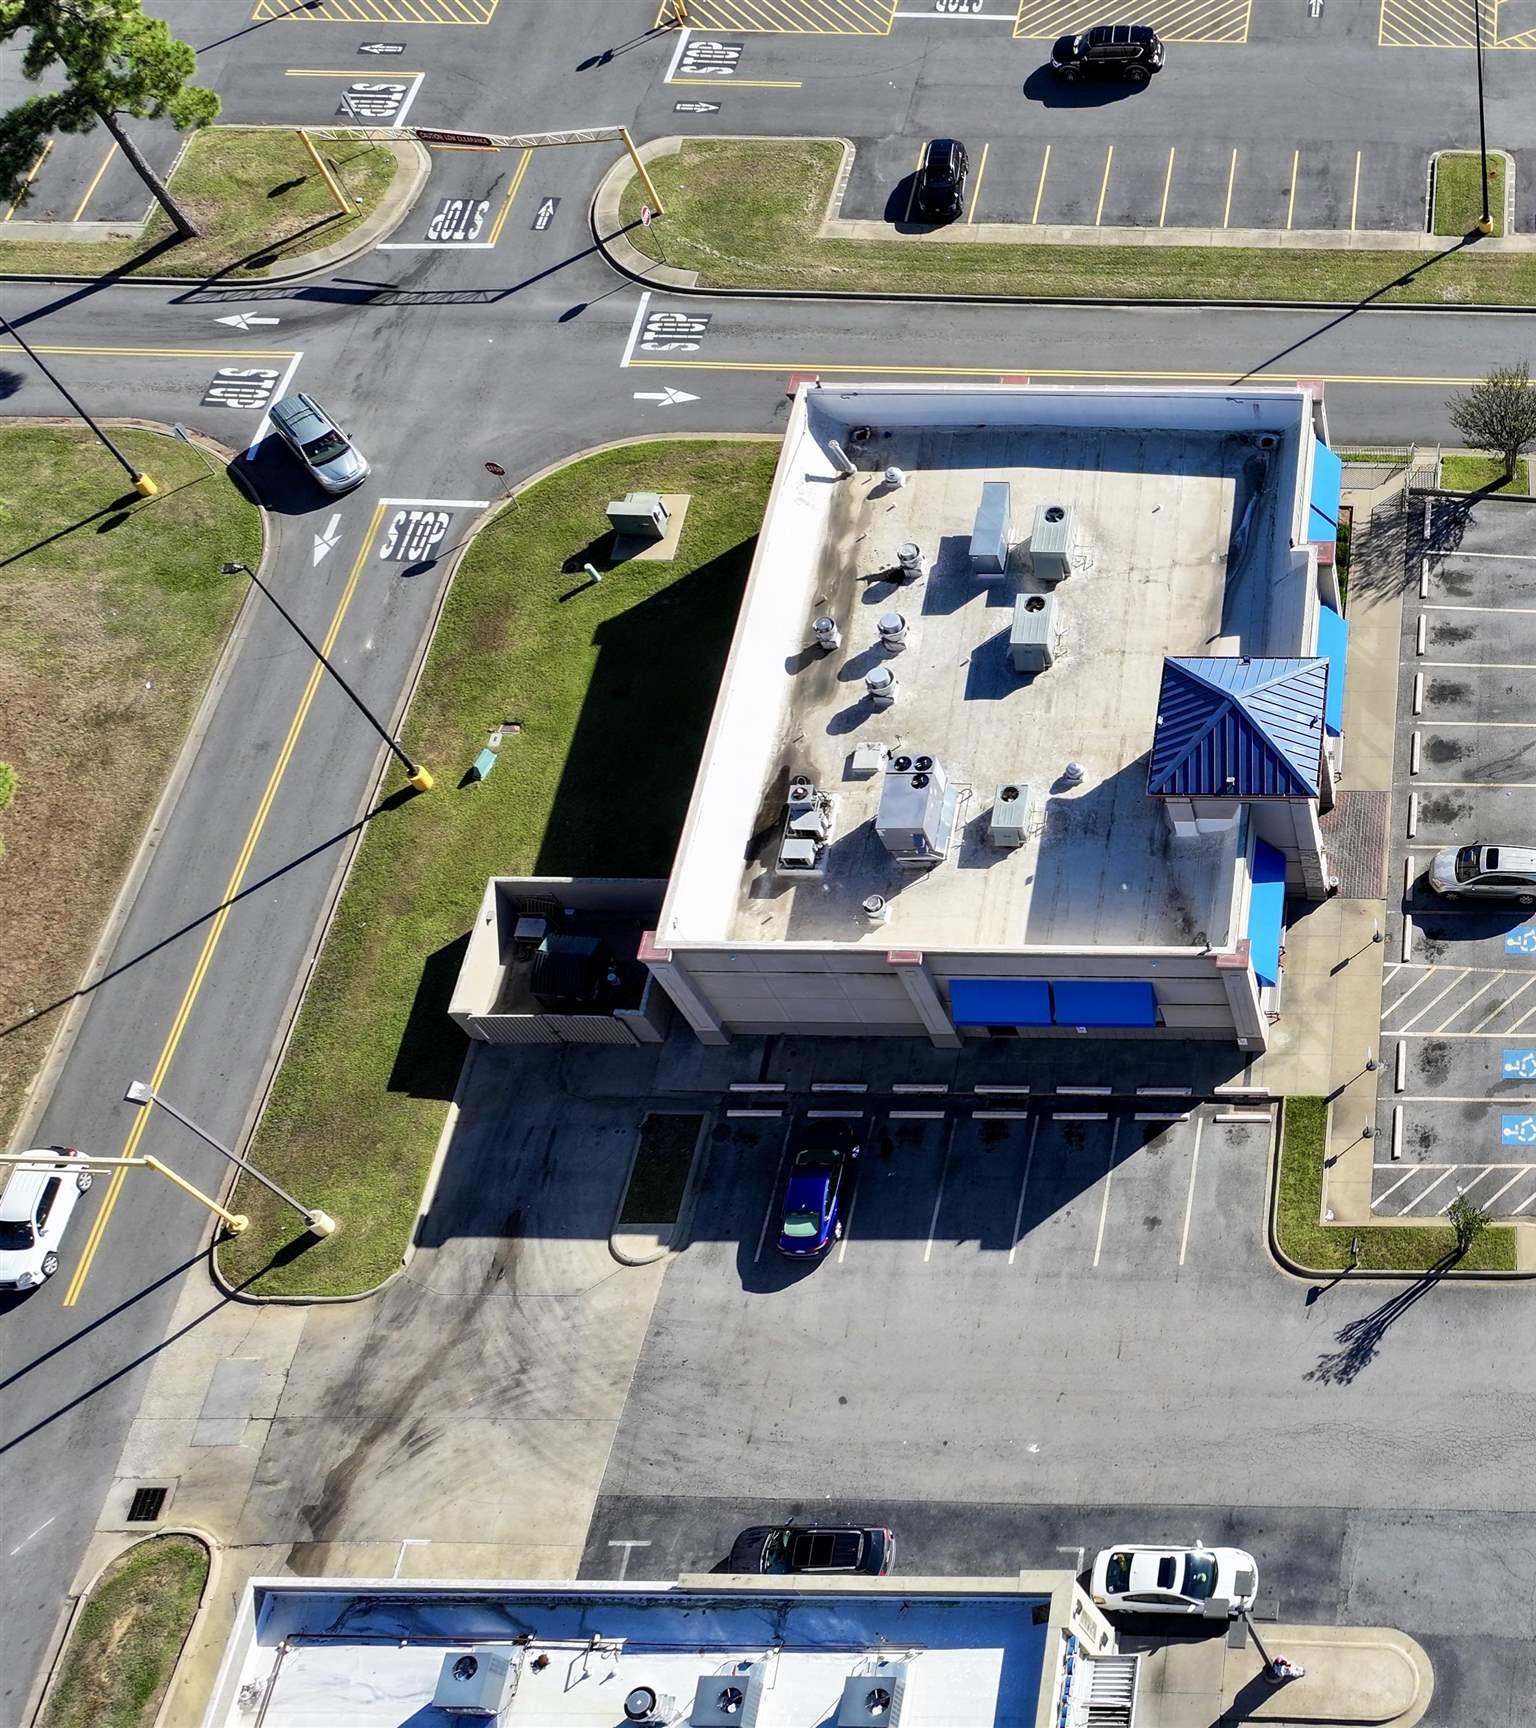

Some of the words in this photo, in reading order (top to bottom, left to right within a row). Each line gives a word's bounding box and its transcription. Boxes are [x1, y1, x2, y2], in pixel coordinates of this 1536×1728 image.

[680, 41, 742, 75] STOP
[341, 83, 407, 117] STOP
[427, 200, 490, 240] STOP
[640, 313, 708, 351] STOP
[204, 367, 280, 409] STOP
[379, 510, 450, 561] STOP
